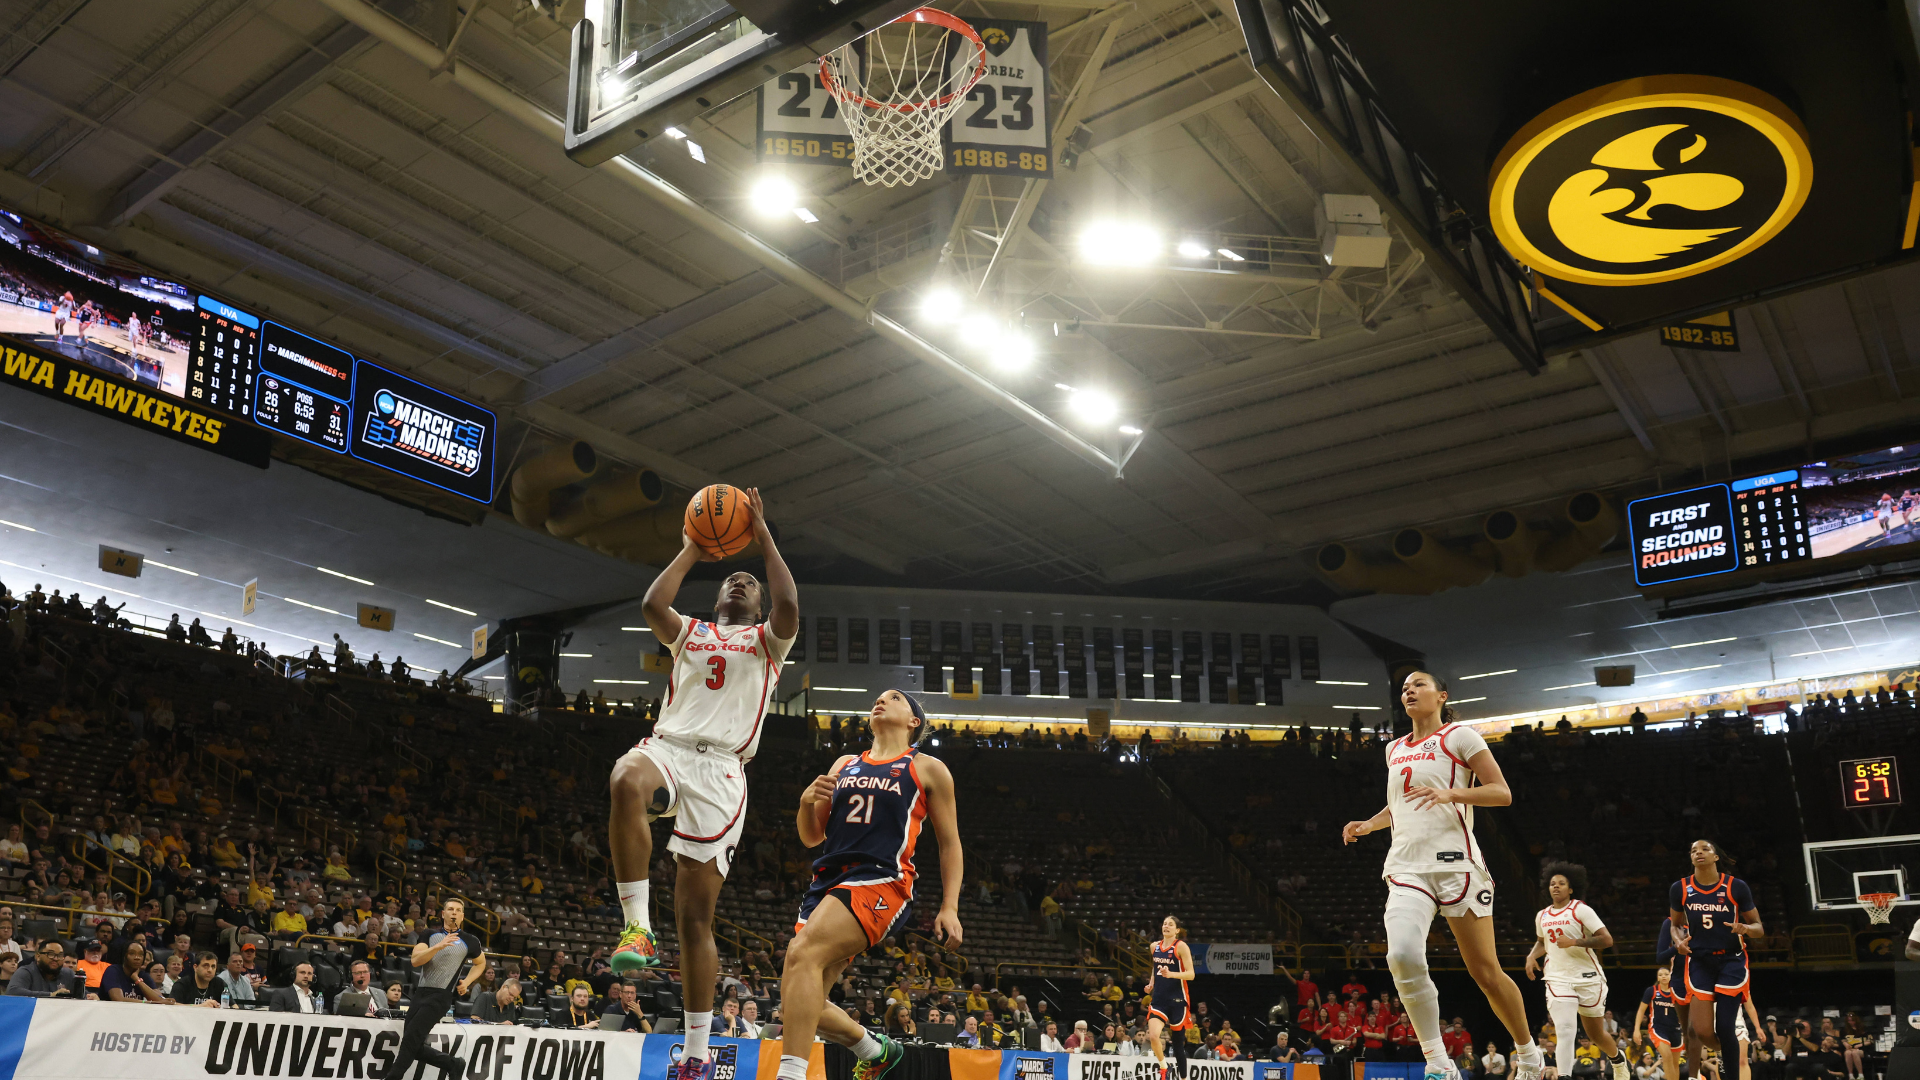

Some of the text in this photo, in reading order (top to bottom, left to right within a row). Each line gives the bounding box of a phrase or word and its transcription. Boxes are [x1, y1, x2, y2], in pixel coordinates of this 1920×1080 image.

[778, 73, 847, 119] 27
[966, 84, 1033, 130] 23
[953, 149, 1047, 171] 1986-89
[220, 306, 237, 320] UVA
[200, 312, 211, 320] PLY
[216, 318, 228, 327] PTS
[233, 325, 244, 334] REB
[201, 325, 254, 355] 1 0 0 1
[1663, 327, 1734, 345] 1982-85
[199, 341, 252, 370] 5 12 5 1
[197, 356, 252, 385] 8 2 1 0
[0, 345, 55, 389] WA
[64, 370, 223, 444] HAWKEYES
[194, 371, 249, 400] 21 11 2 1
[192, 386, 249, 415] 23 2 1 0
[265, 391, 279, 407] 26
[296, 391, 313, 406] POSS
[379, 401, 394, 410] NCAA
[274, 415, 279, 423] 2
[294, 402, 315, 420] 6:52
[394, 400, 454, 439] MARCH
[295, 420, 310, 434] 2ND
[329, 414, 341, 431] 31
[338, 438, 344, 446] 3
[400, 423, 479, 469] MADNESS
[1754, 477, 1775, 486] UGA
[1741, 494, 1798, 513] 0 0 2 1
[1649, 503, 1710, 527] FIRST
[1742, 517, 1749, 526] 2
[1776, 511, 1783, 520] 1
[1793, 507, 1799, 517] 1
[1672, 523, 1688, 531] AND
[1744, 521, 1802, 539] 3 2 1 0
[1642, 525, 1723, 552] SECOND
[1743, 533, 1803, 552] 14 11 0 0
[115, 558, 126, 568] N
[1642, 541, 1726, 569] ROUNDS
[1745, 547, 1805, 566] 33 7 0 0
[371, 613, 382, 622] M
[685, 641, 758, 657] GEORGIA
[706, 655, 726, 690] 3
[1389, 752, 1436, 767] GEORGIA
[1856, 762, 1890, 778] 6:52
[836, 776, 902, 796] VIRGINIA
[1400, 766, 1414, 794] 2
[1854, 777, 1890, 801] 27
[845, 794, 874, 824] 21
[1476, 889, 1491, 907] G
[1686, 903, 1730, 912] VIRGINIA
[1702, 914, 1713, 929] 5
[1213, 952, 1234, 960] FIRST
[1241, 952, 1270, 960] SECOND
[1226, 962, 1259, 970] ROUNDS
[90, 1032, 196, 1055] HOSTED BY
[205, 1020, 605, 1080] UNIVERSTY OF IOWA
[1022, 1060, 1045, 1072] MARCH
[1081, 1061, 1121, 1080] FIRST
[1135, 1062, 1181, 1080] SECN
[1190, 1061, 1244, 1080] ROUNDS
